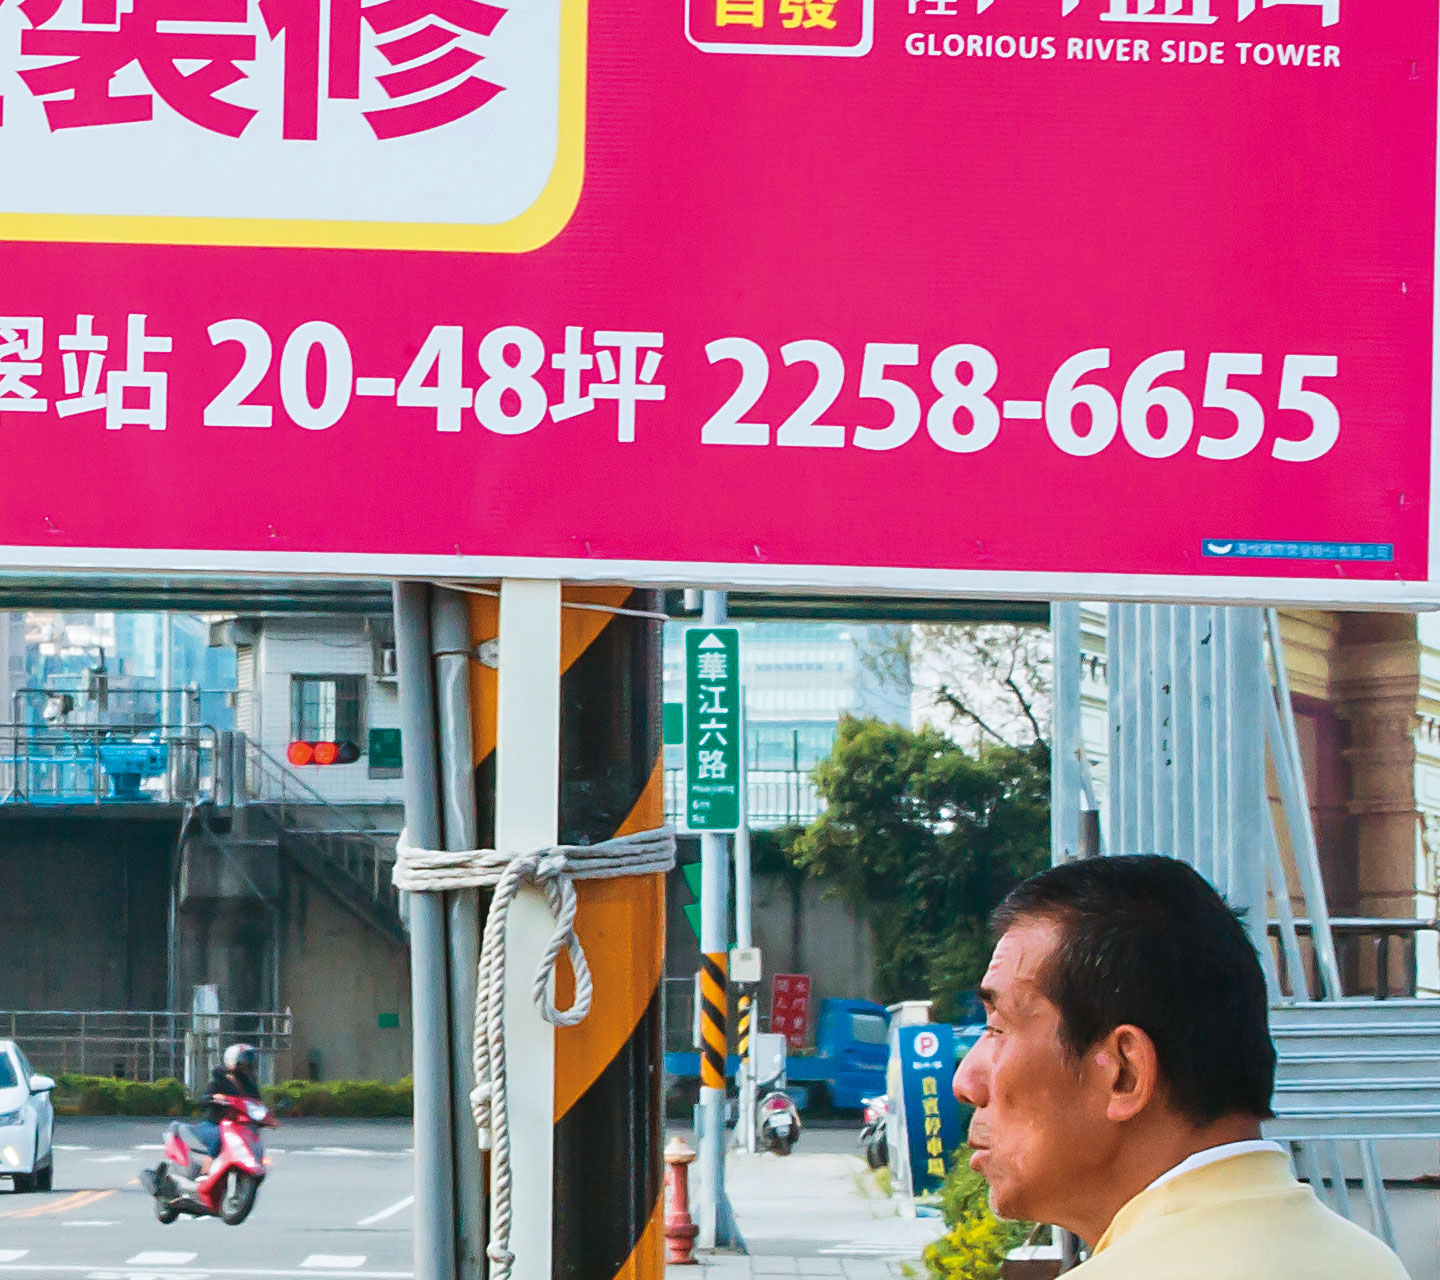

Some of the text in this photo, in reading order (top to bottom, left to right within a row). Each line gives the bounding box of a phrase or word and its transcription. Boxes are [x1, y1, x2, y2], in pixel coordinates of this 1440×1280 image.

[905, 32, 1341, 68] GLORIOUS RIVER SIDE TOWER
[203, 318, 667, 443] 20-48坪
[700, 336, 1341, 463] 2258-6655
[697, 651, 728, 779] 華江六路
